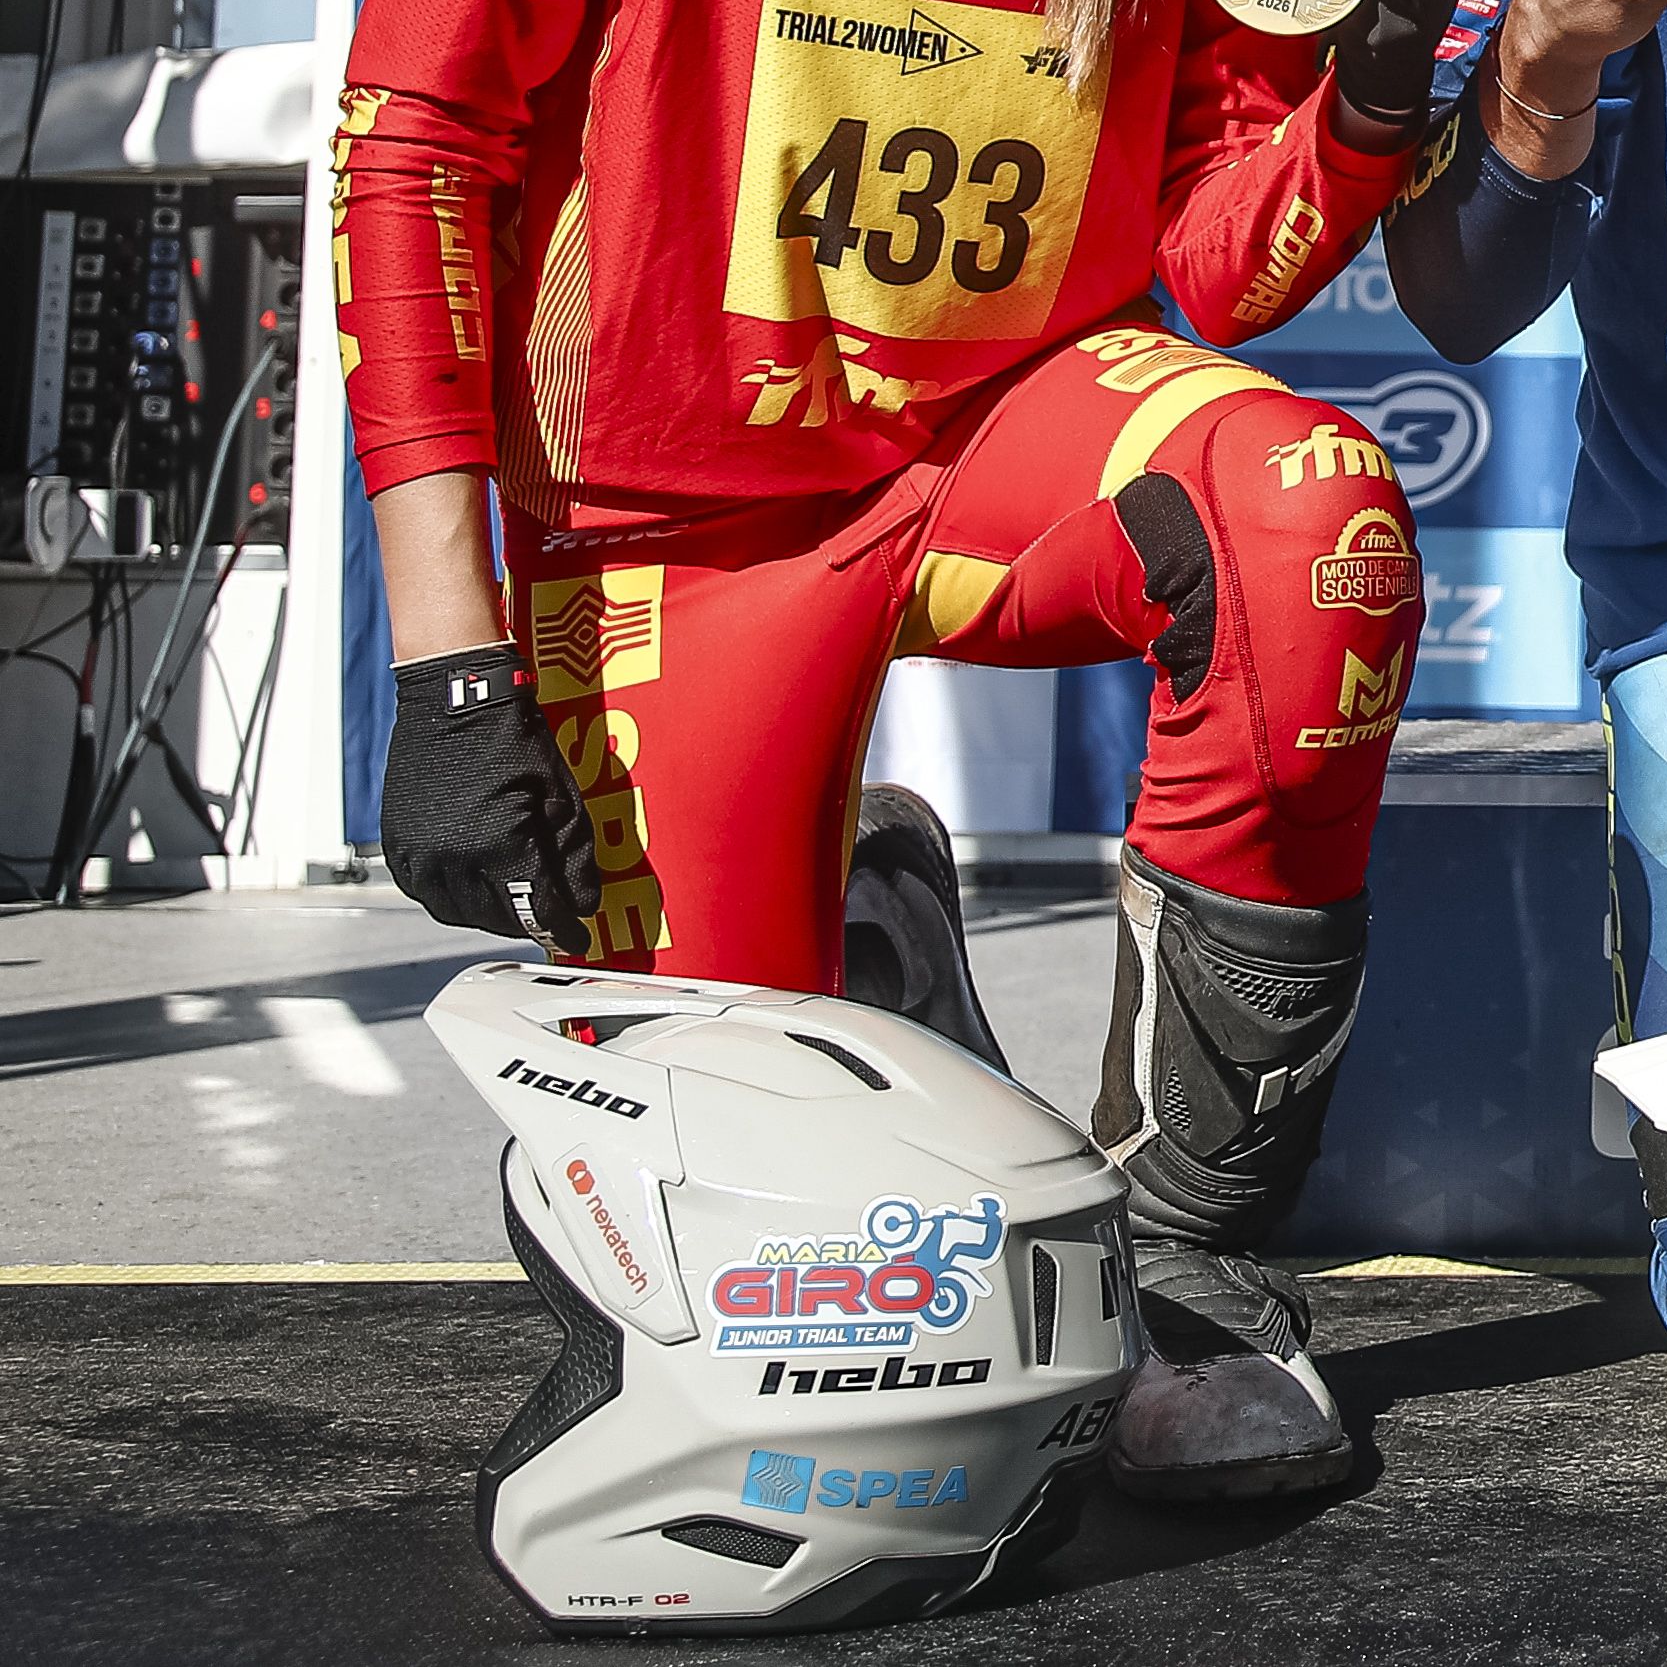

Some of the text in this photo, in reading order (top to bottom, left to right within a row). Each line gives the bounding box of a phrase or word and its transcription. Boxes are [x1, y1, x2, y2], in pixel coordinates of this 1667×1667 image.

[775, 8, 949, 65] TRIAL2WOMEN
[776, 118, 1046, 294] 433
[1321, 559, 1367, 580] MOTO
[1369, 560, 1385, 577] DE
[1321, 576, 1418, 602] SOSTENIBLE
[497, 1056, 651, 1121] hebo
[586, 1191, 649, 1295] nexatech
[757, 1243, 882, 1265] MARIA
[713, 1255, 937, 1319] GIRÓ
[720, 1323, 908, 1348] JUNIOR TRIAL TEAM
[756, 1356, 992, 1398] hebo
[816, 1464, 969, 1510] SPEA
[567, 1592, 692, 1607] HTR-F 02
